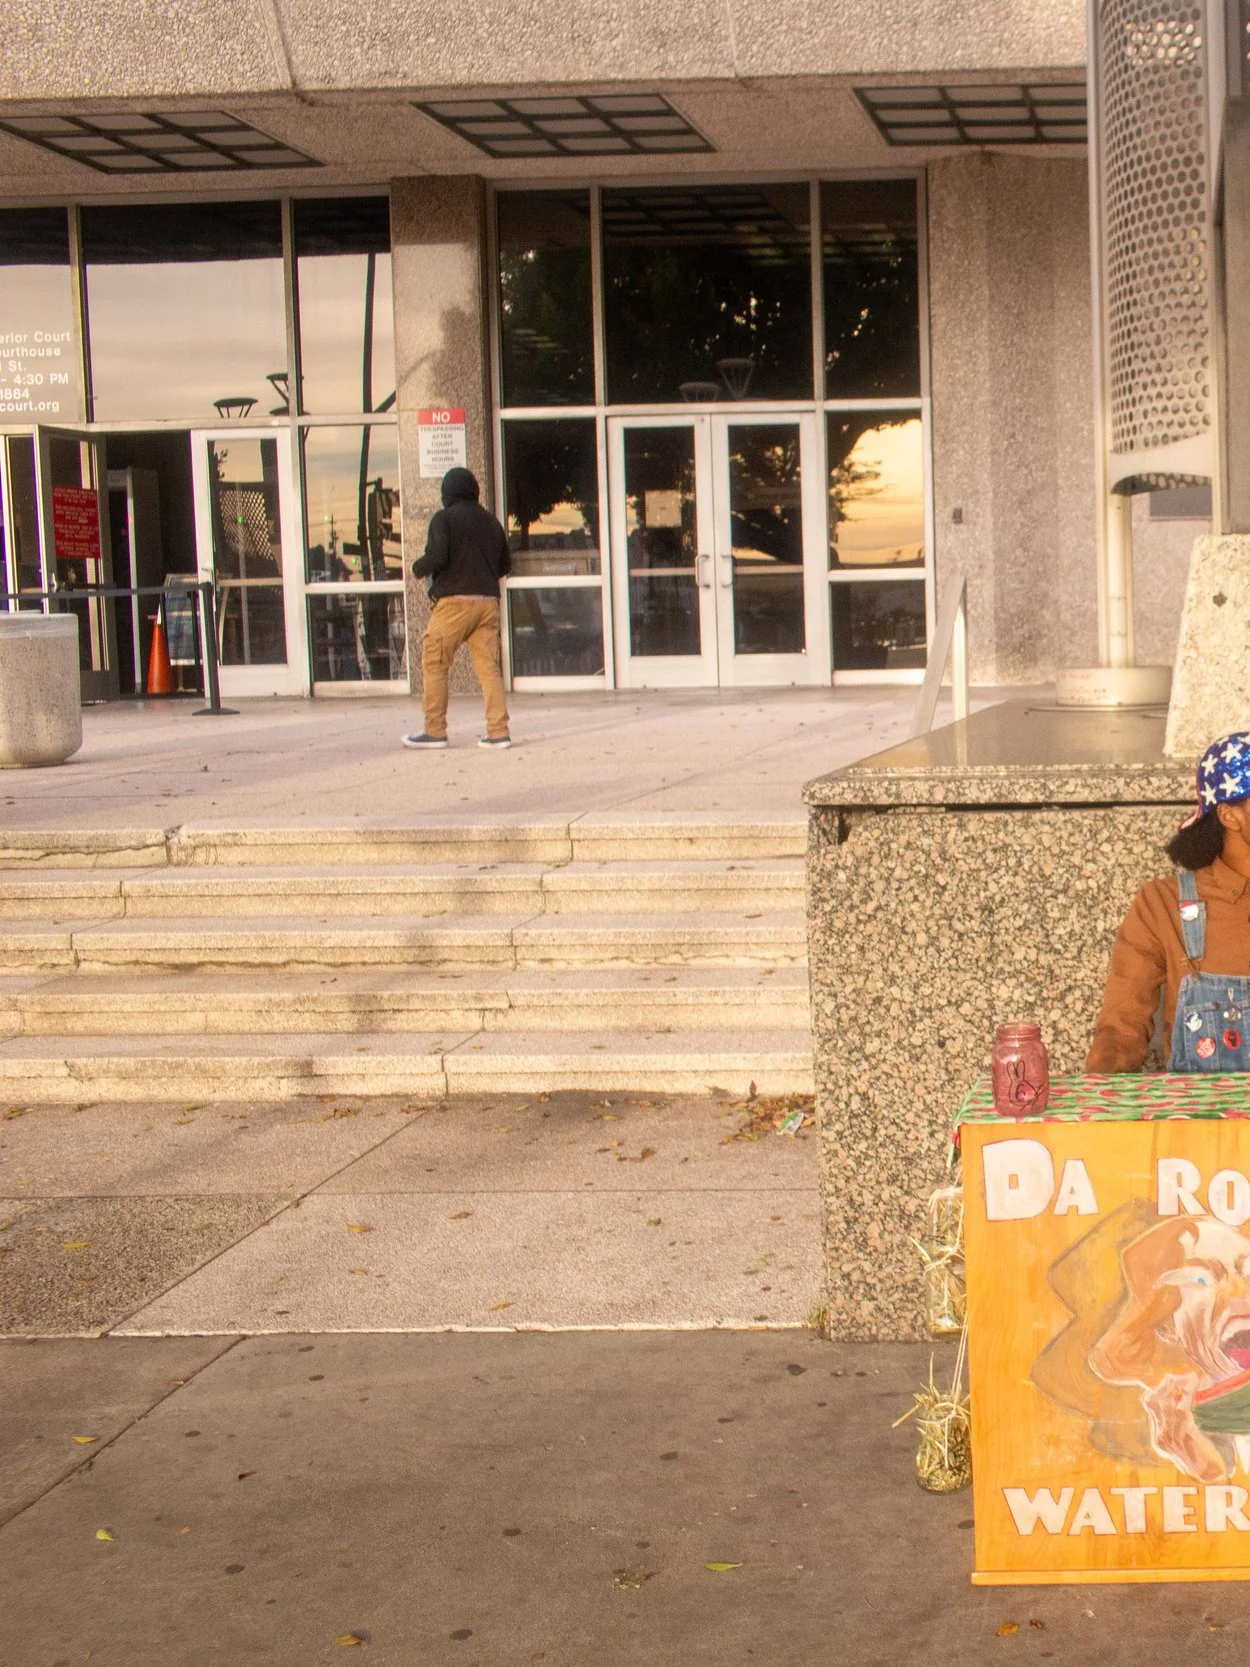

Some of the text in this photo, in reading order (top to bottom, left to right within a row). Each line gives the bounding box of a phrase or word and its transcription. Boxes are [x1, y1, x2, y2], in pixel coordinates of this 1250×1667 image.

[34, 330, 71, 343] Court
[0, 346, 61, 358] urthouse
[8, 360, 27, 372] St.
[14, 373, 44, 386] 4:30
[50, 372, 69, 385] PM
[431, 411, 451, 423] NO
